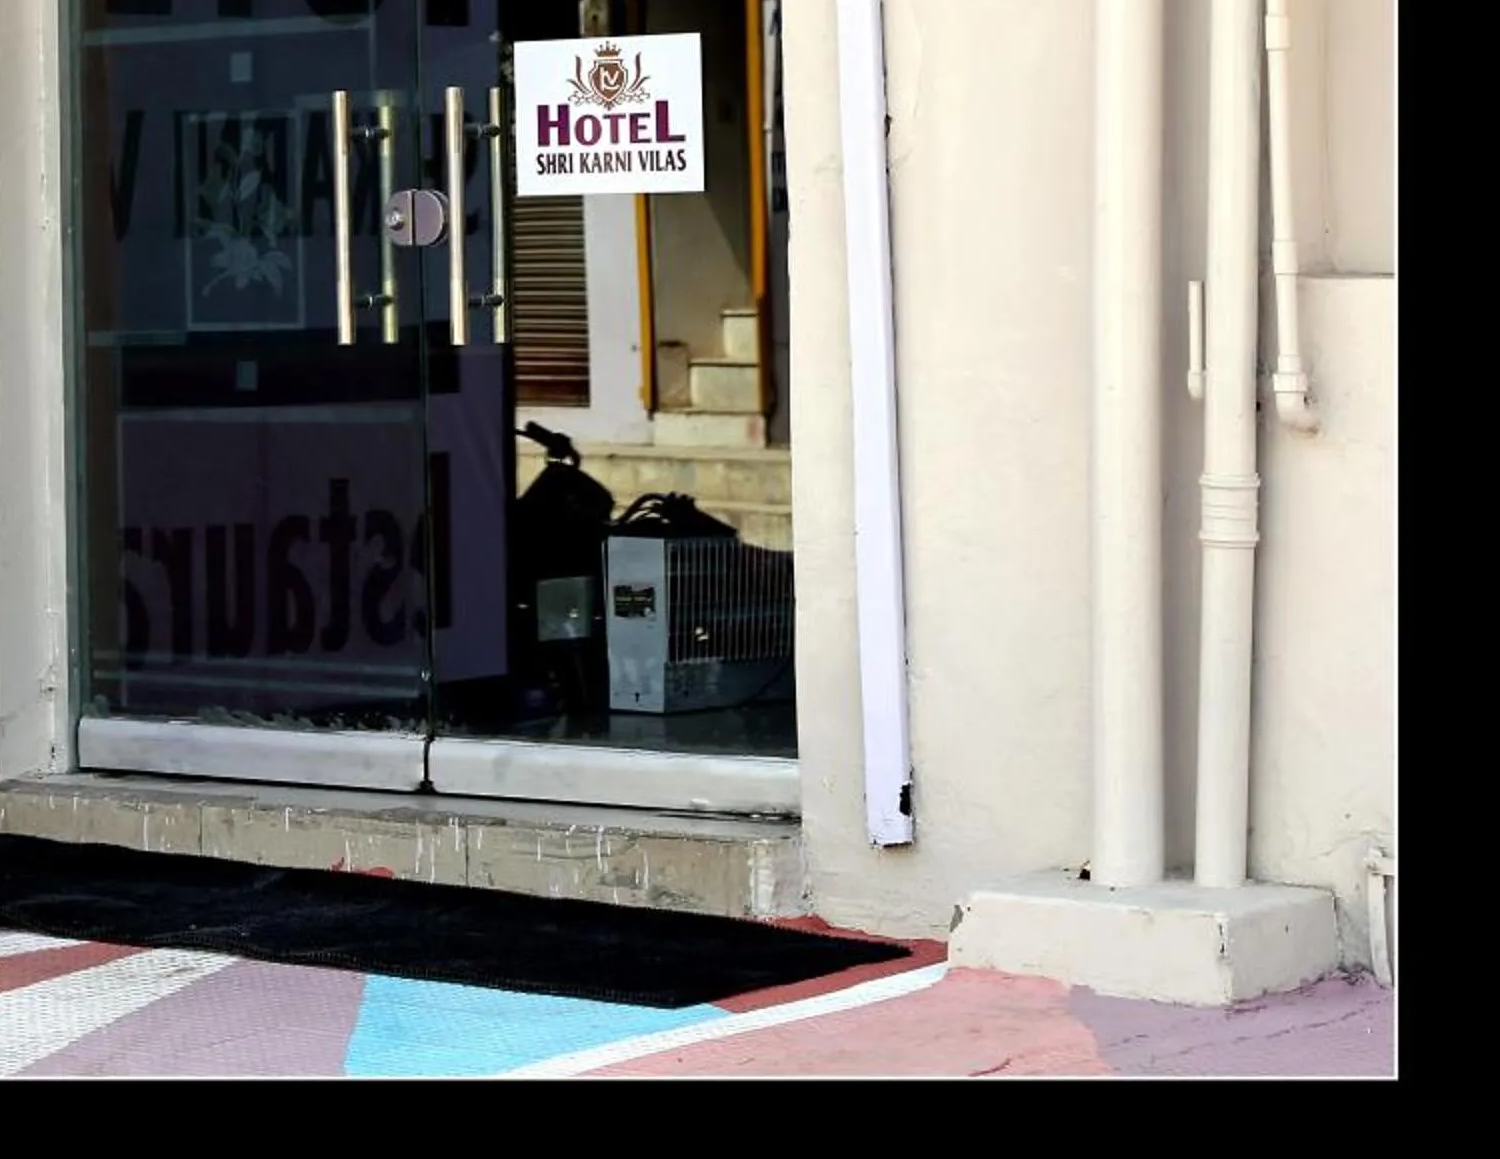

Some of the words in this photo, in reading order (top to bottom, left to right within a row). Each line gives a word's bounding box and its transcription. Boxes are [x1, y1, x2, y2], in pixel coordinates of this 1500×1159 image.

[537, 100, 686, 147] HOTEL
[536, 152, 574, 175] SHRI
[579, 150, 632, 174] KARNI
[638, 148, 687, 172] VILAS
